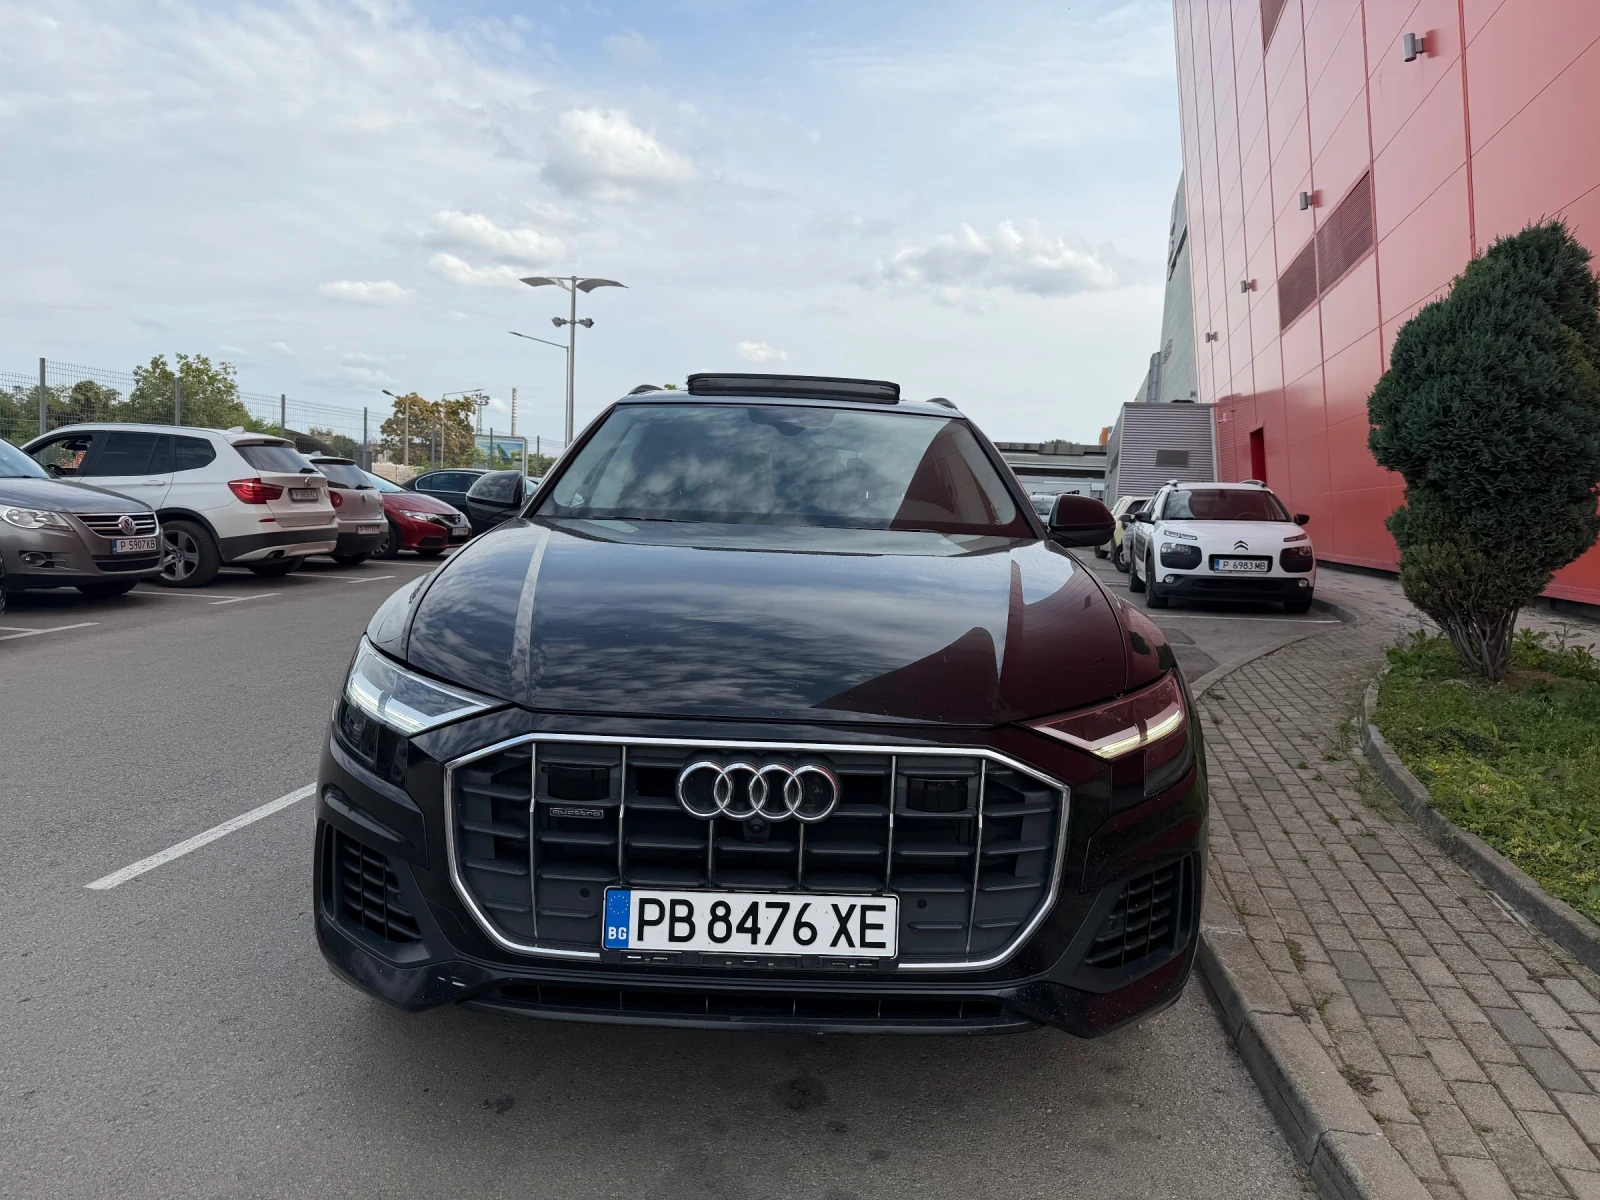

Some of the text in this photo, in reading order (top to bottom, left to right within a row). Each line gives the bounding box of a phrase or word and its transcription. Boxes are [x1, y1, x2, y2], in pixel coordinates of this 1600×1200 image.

[552, 809, 601, 817] quattro
[637, 897, 887, 949] PB 8476 XE
[607, 927, 627, 940] BG
